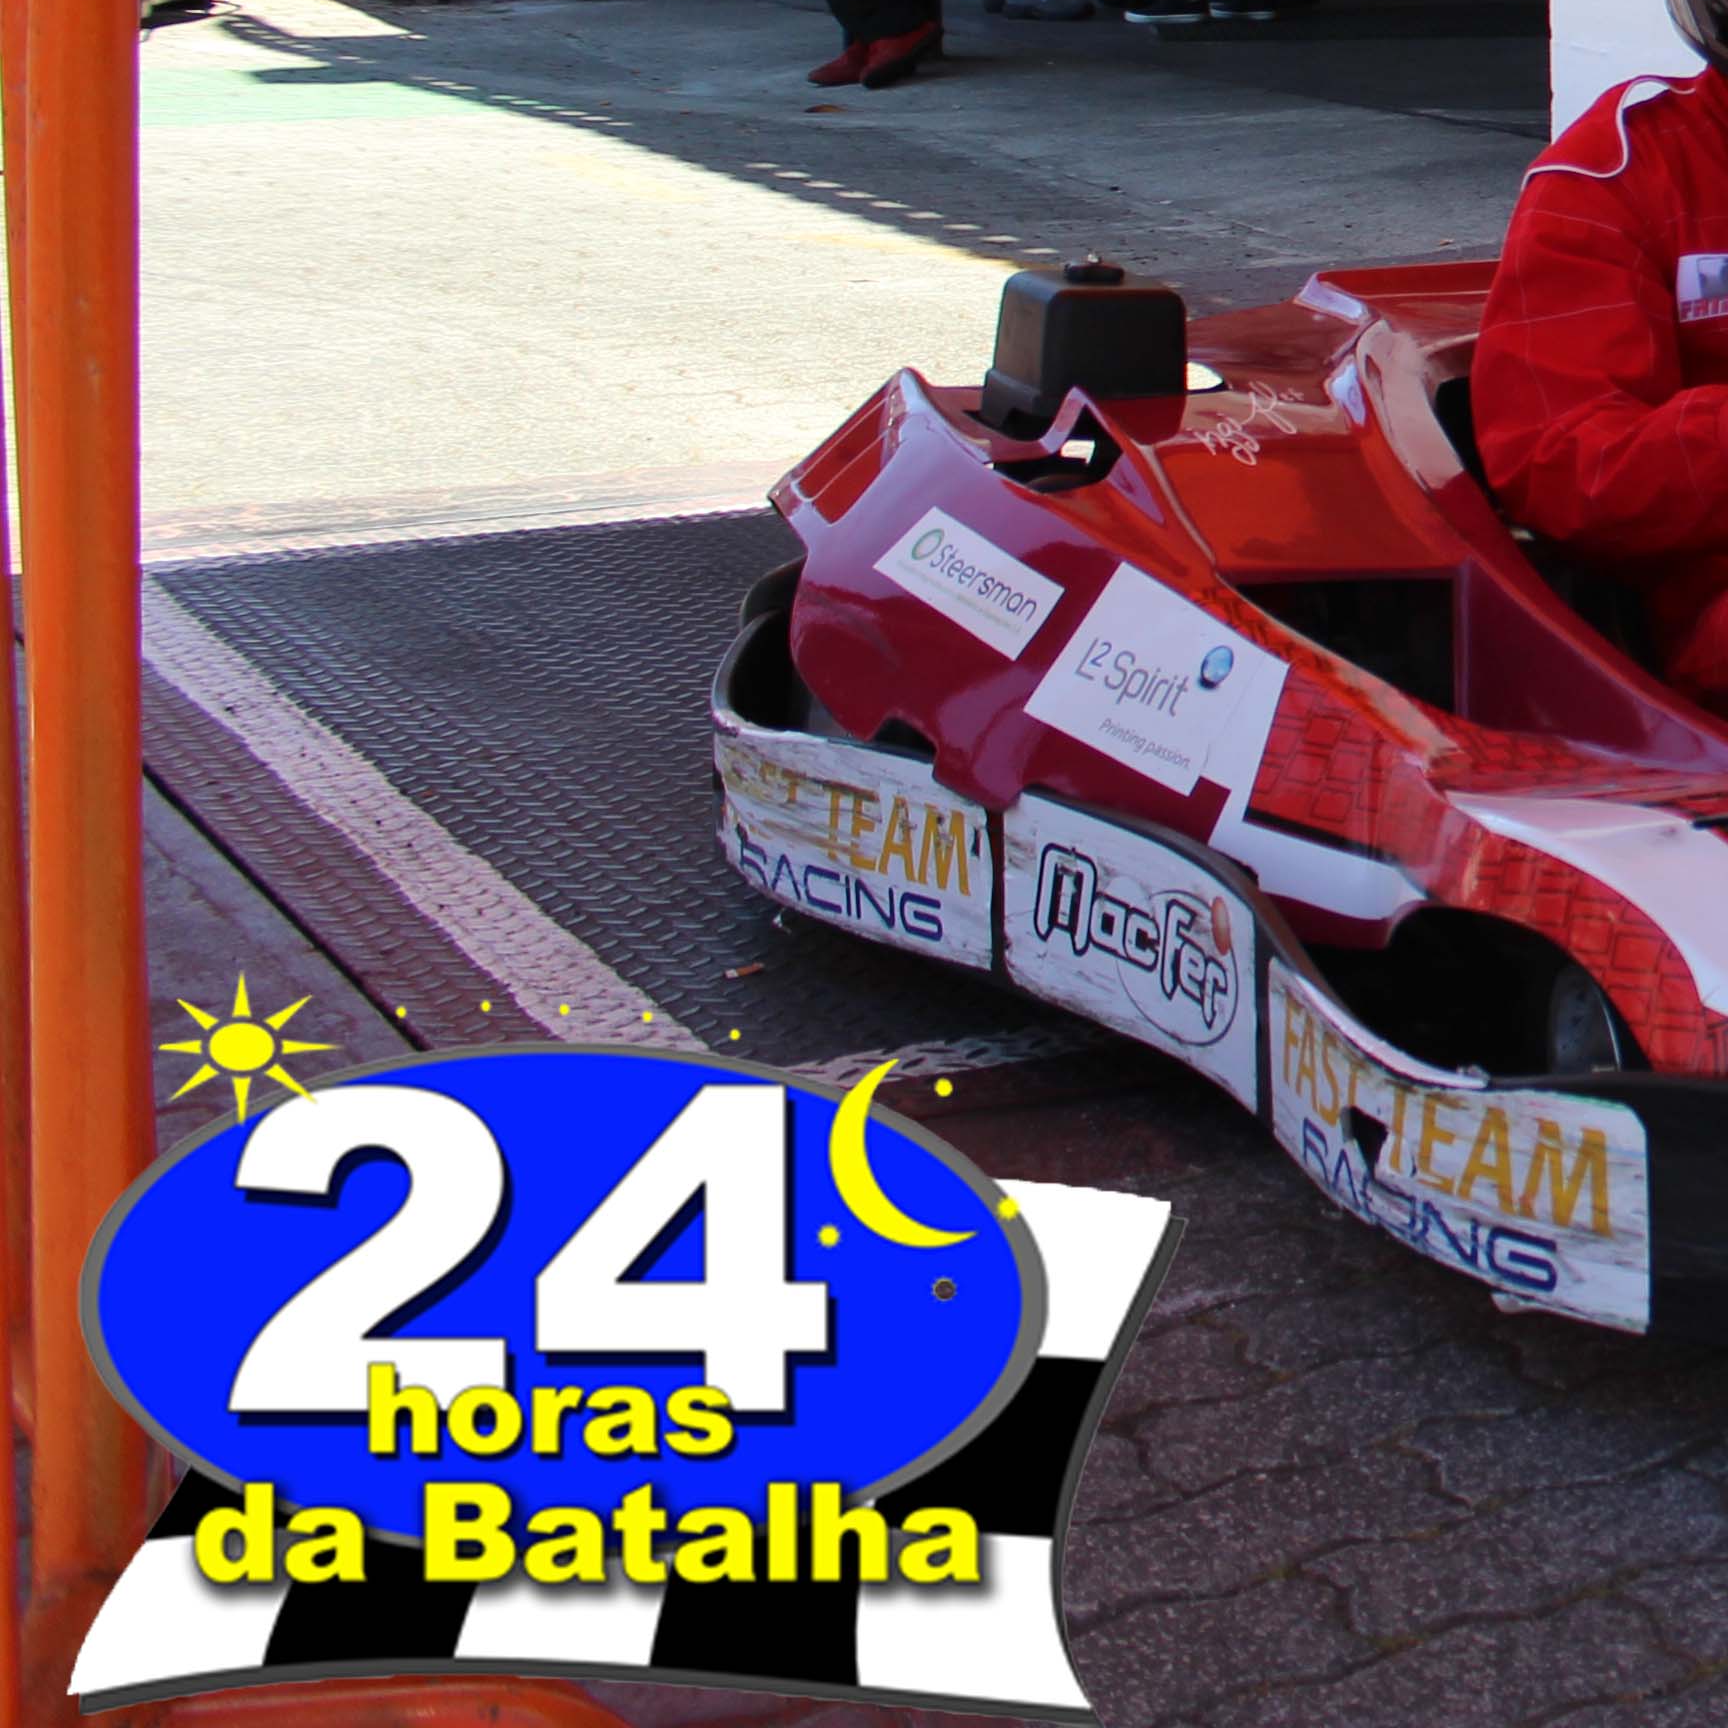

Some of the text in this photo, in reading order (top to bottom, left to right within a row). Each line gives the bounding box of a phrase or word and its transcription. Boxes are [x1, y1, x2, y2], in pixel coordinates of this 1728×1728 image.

[1105, 649, 1190, 718] Spirit
[1099, 717, 1147, 754] Printing
[823, 780, 971, 896] TEAM
[1384, 1078, 1613, 1239] TEAM
